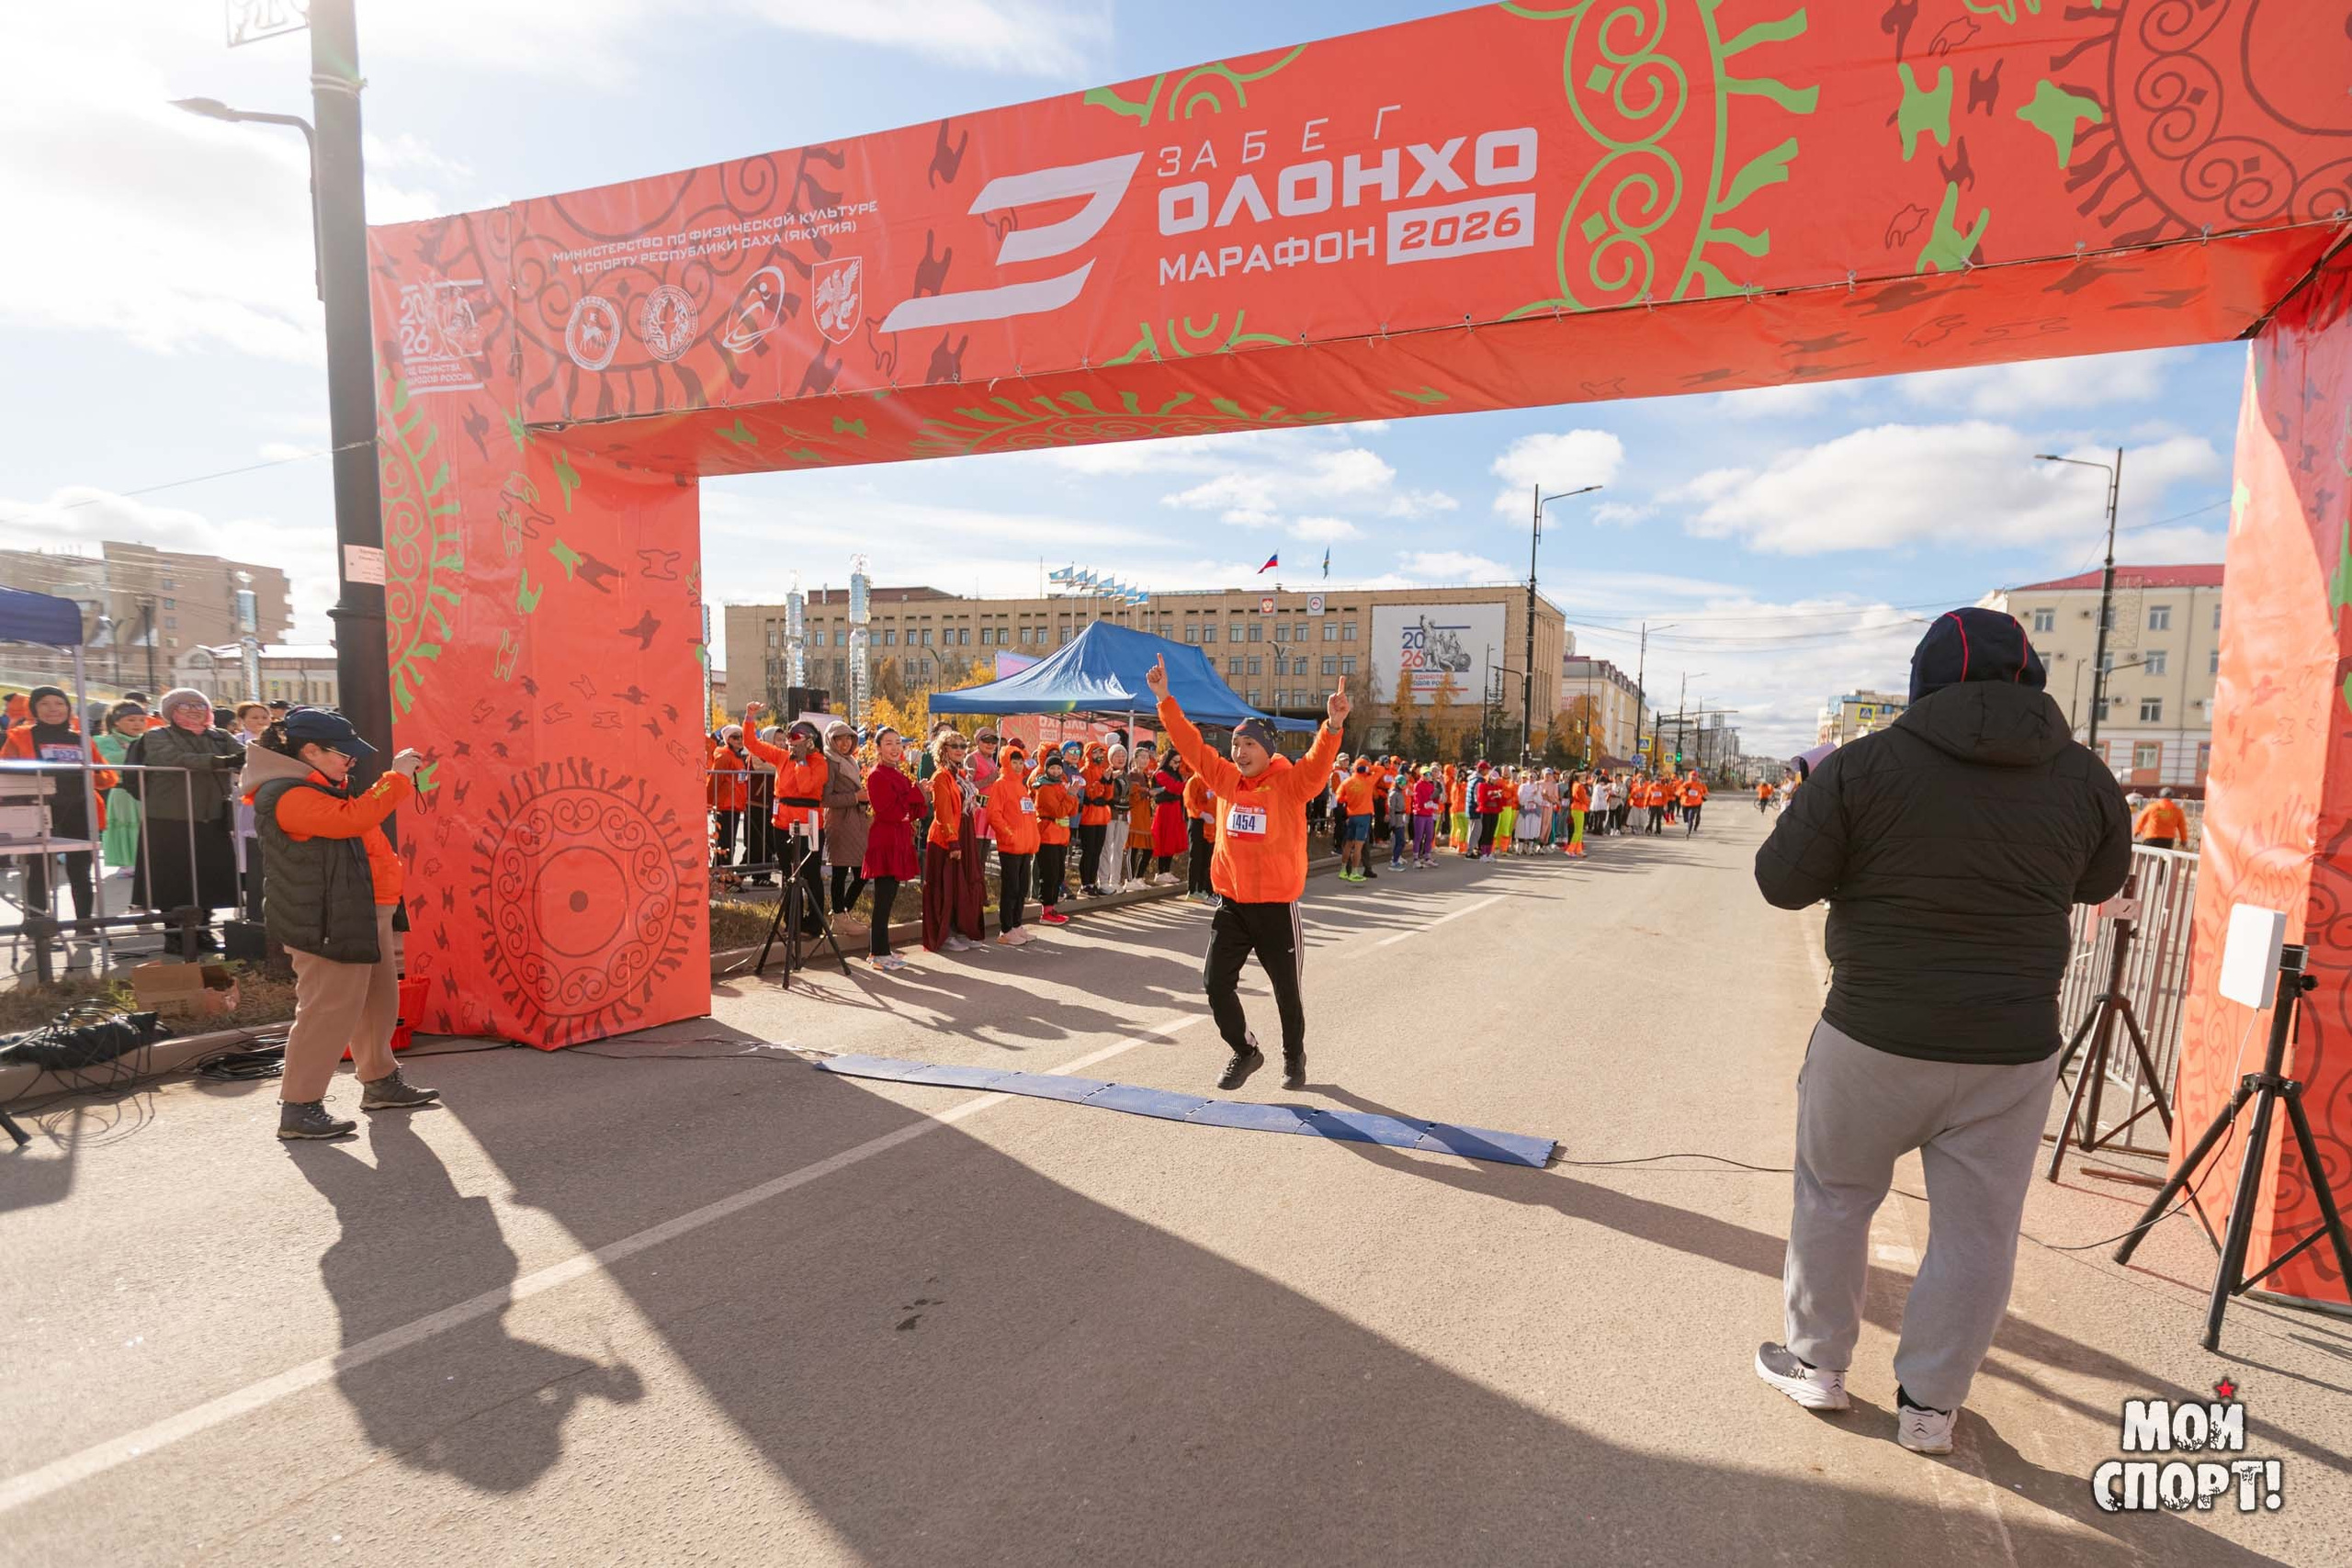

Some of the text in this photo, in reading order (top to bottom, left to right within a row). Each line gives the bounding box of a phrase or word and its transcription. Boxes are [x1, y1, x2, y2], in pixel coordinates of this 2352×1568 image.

[1158, 105, 1401, 176] ЗАБЕГ
[1159, 127, 1538, 236] ОЛОНХО
[553, 201, 878, 262] МИНИСТЕРСТВО ПО ФИЗИЧЕСКОЙ КУЛЬТУРЕ
[573, 220, 857, 275] И СПОРТУ РЕСПУБЛИКИ САХА (ЯКУТИЯ)
[1159, 207, 1521, 286] МАРАФОН 2026
[401, 325, 430, 355] 26
[1401, 650, 1424, 668] 26
[1402, 632, 1425, 649] 20
[1232, 814, 1256, 830] 1454
